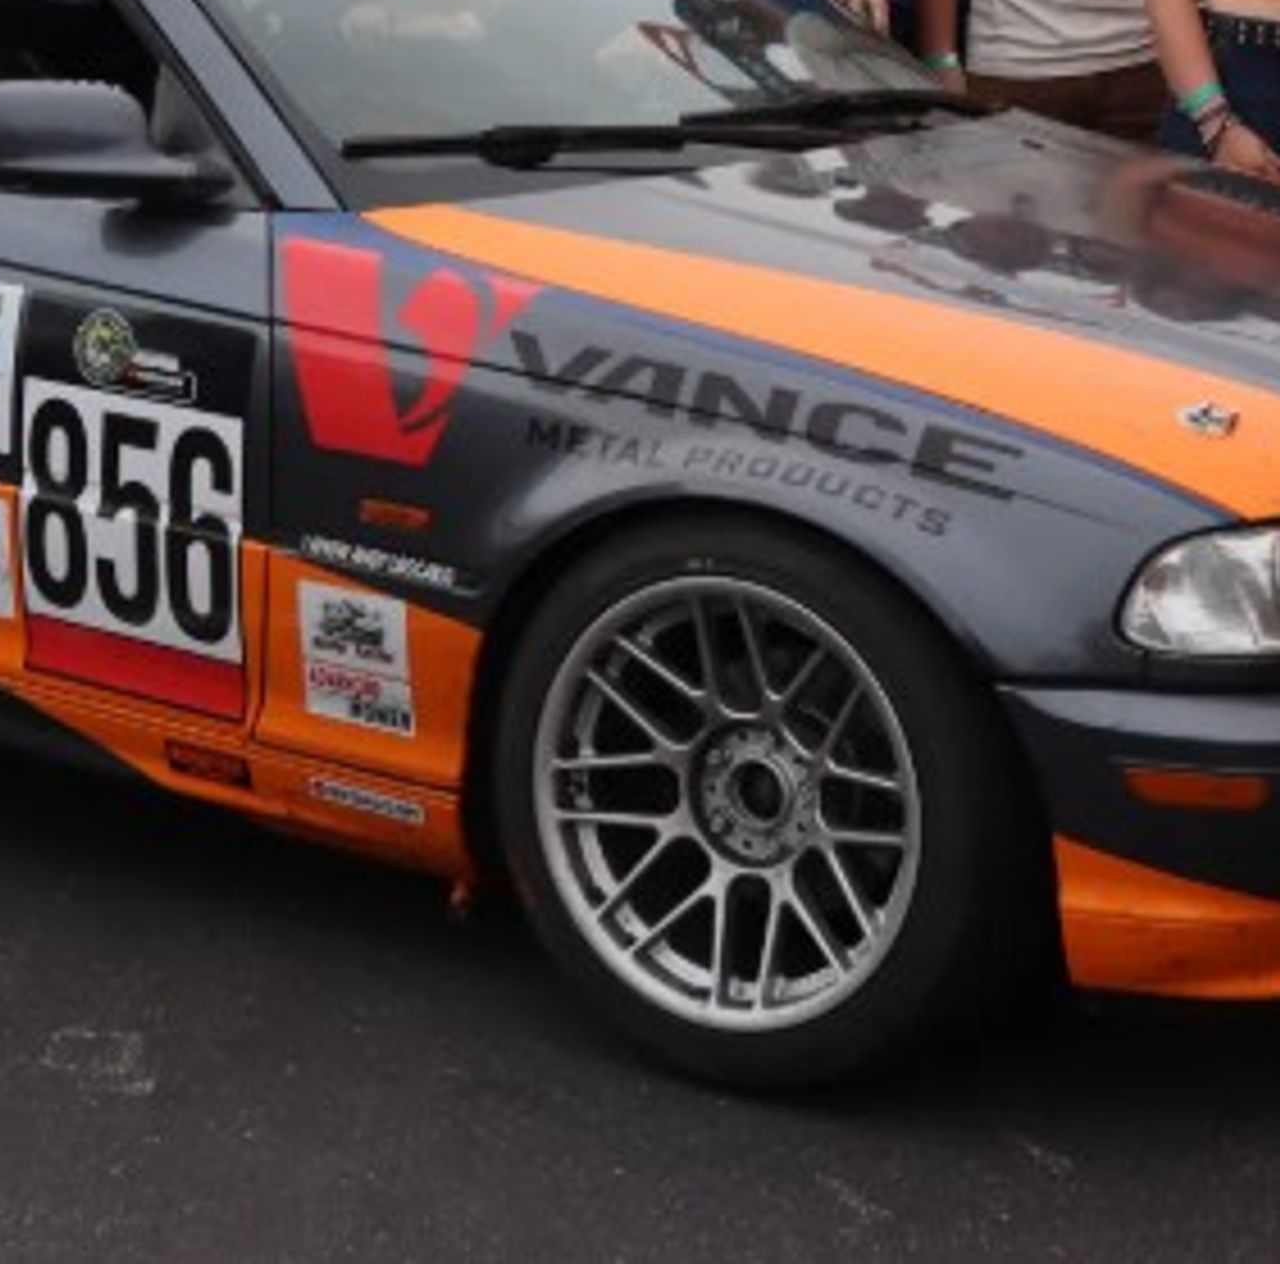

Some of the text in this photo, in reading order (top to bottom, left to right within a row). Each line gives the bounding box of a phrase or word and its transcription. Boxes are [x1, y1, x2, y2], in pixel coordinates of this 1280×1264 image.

[509, 330, 1027, 503] VANCE
[525, 417, 955, 538] METAL PRODUCTS
[26, 397, 235, 644] 856
